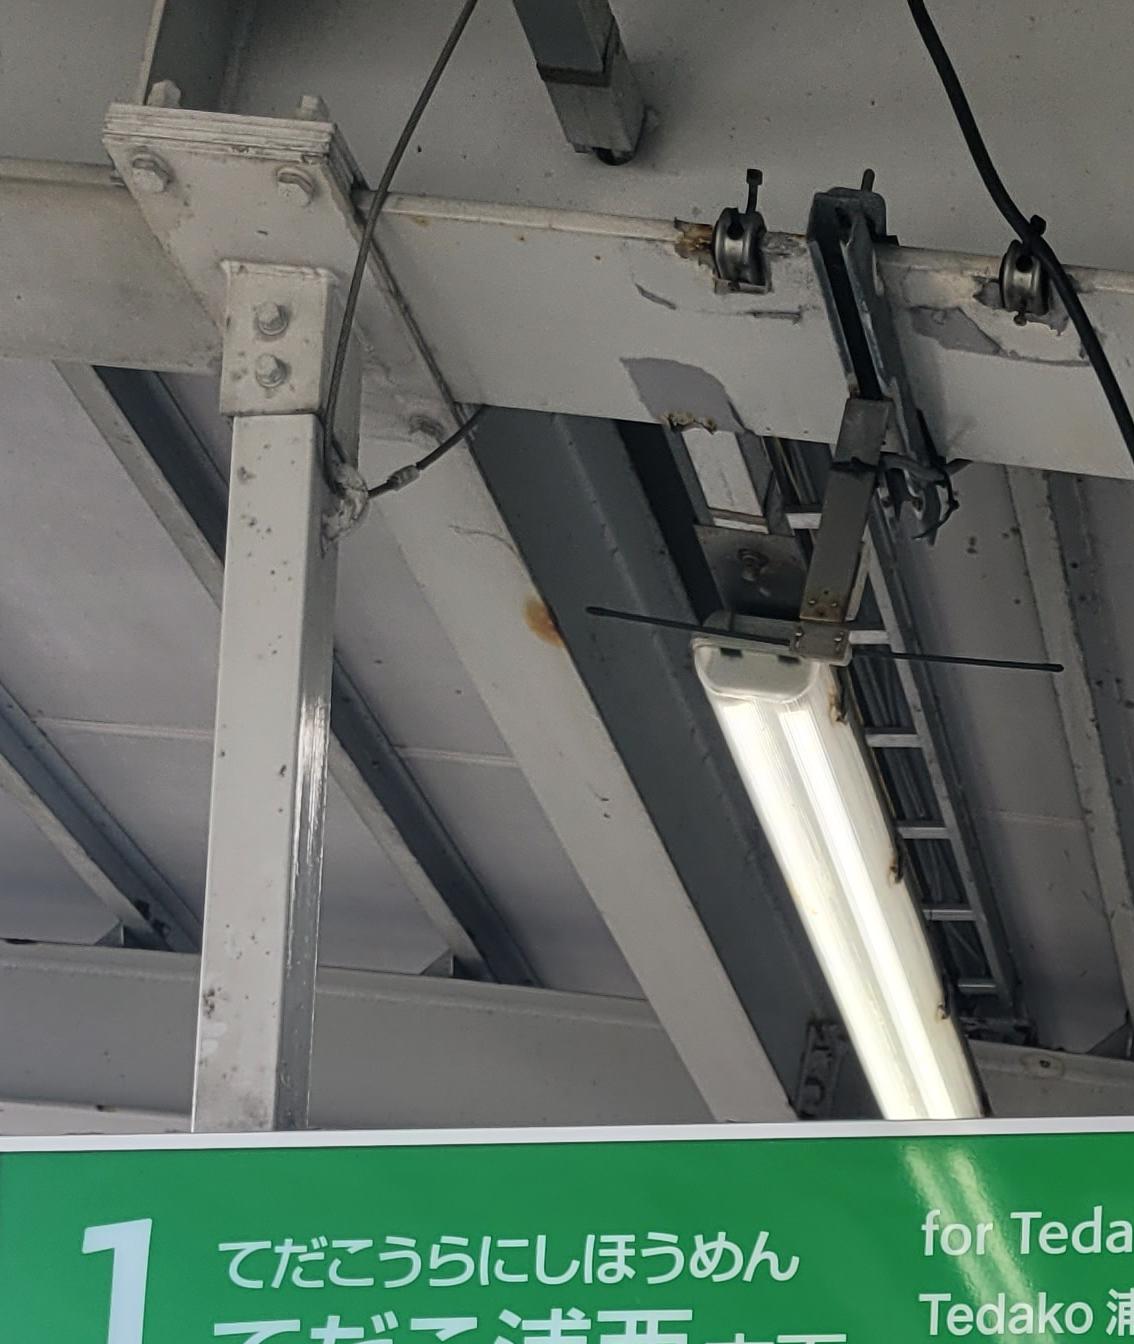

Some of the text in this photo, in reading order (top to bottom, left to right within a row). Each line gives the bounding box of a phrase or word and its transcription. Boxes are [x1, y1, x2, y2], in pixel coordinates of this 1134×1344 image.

[921, 1209, 993, 1257] for
[217, 1230, 800, 1289] てだこうらにしほうめん
[919, 1290, 1093, 1337] Tedako
